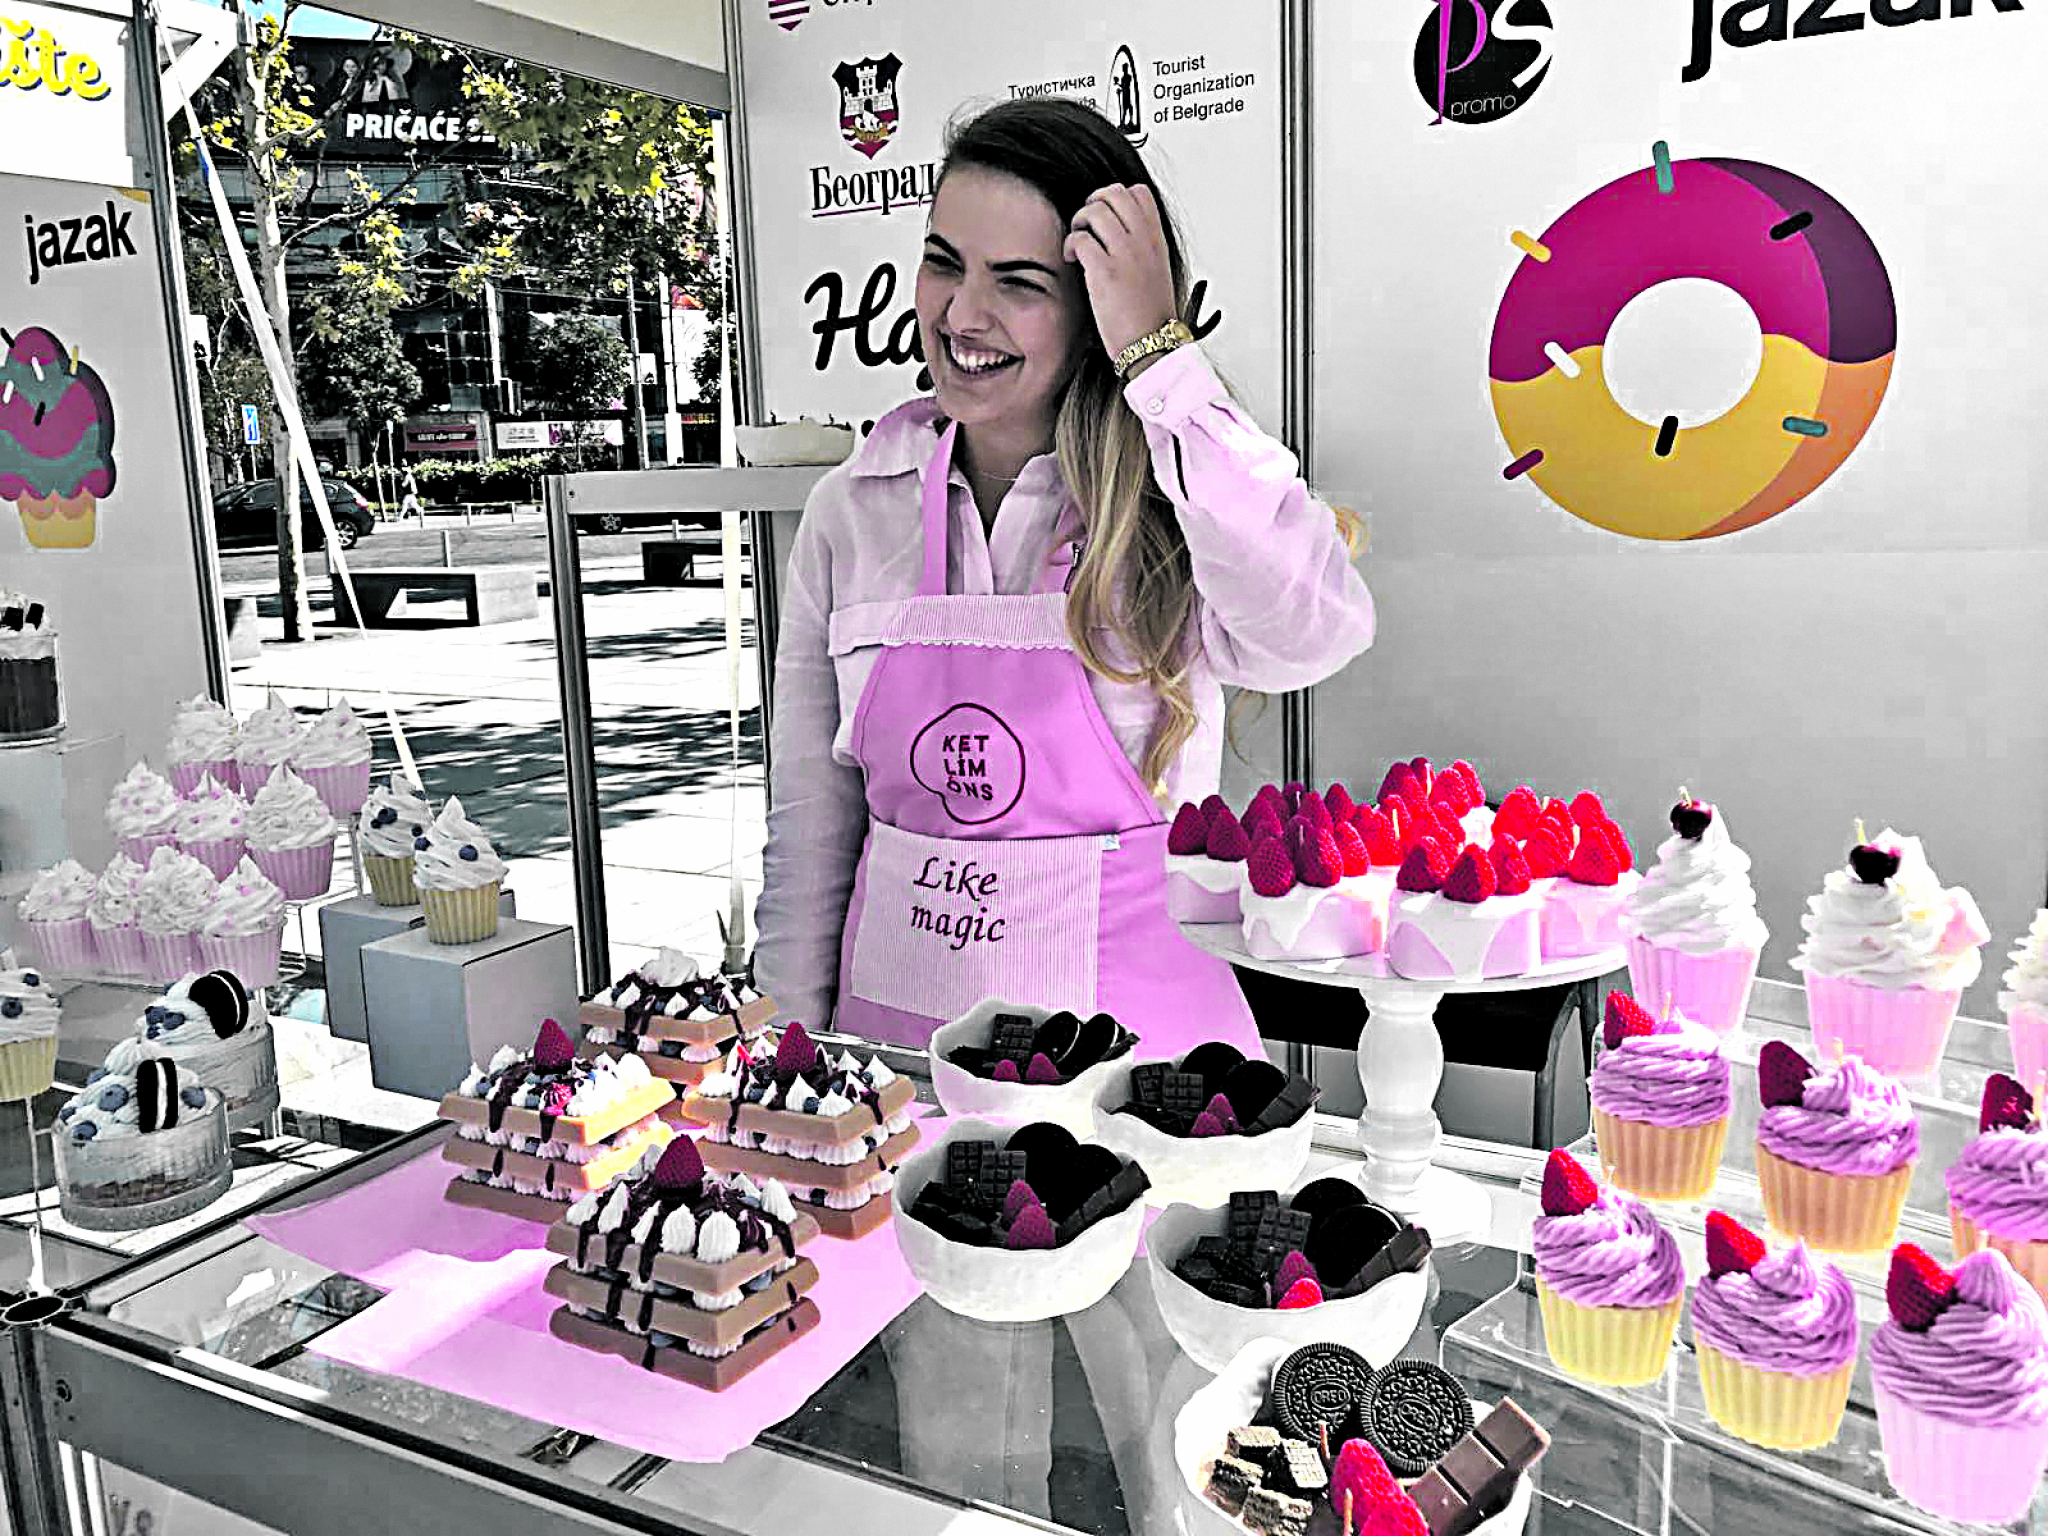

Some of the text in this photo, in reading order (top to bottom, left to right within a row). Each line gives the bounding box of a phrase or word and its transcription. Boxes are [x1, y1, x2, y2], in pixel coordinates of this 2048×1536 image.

[1153, 55, 1206, 77] Tourist
[1007, 74, 1096, 100] Туристичка
[1153, 72, 1255, 101] Organization
[1153, 98, 1245, 124] of Belgrade
[1450, 95, 1517, 120] promo
[346, 108, 461, 142] PRIČAĆE
[809, 163, 935, 216] Београд
[24, 200, 137, 285] jazak
[942, 735, 989, 753] KET
[913, 857, 999, 902] Like
[911, 905, 1006, 951] magic
[1314, 1389, 1347, 1403] OREO
